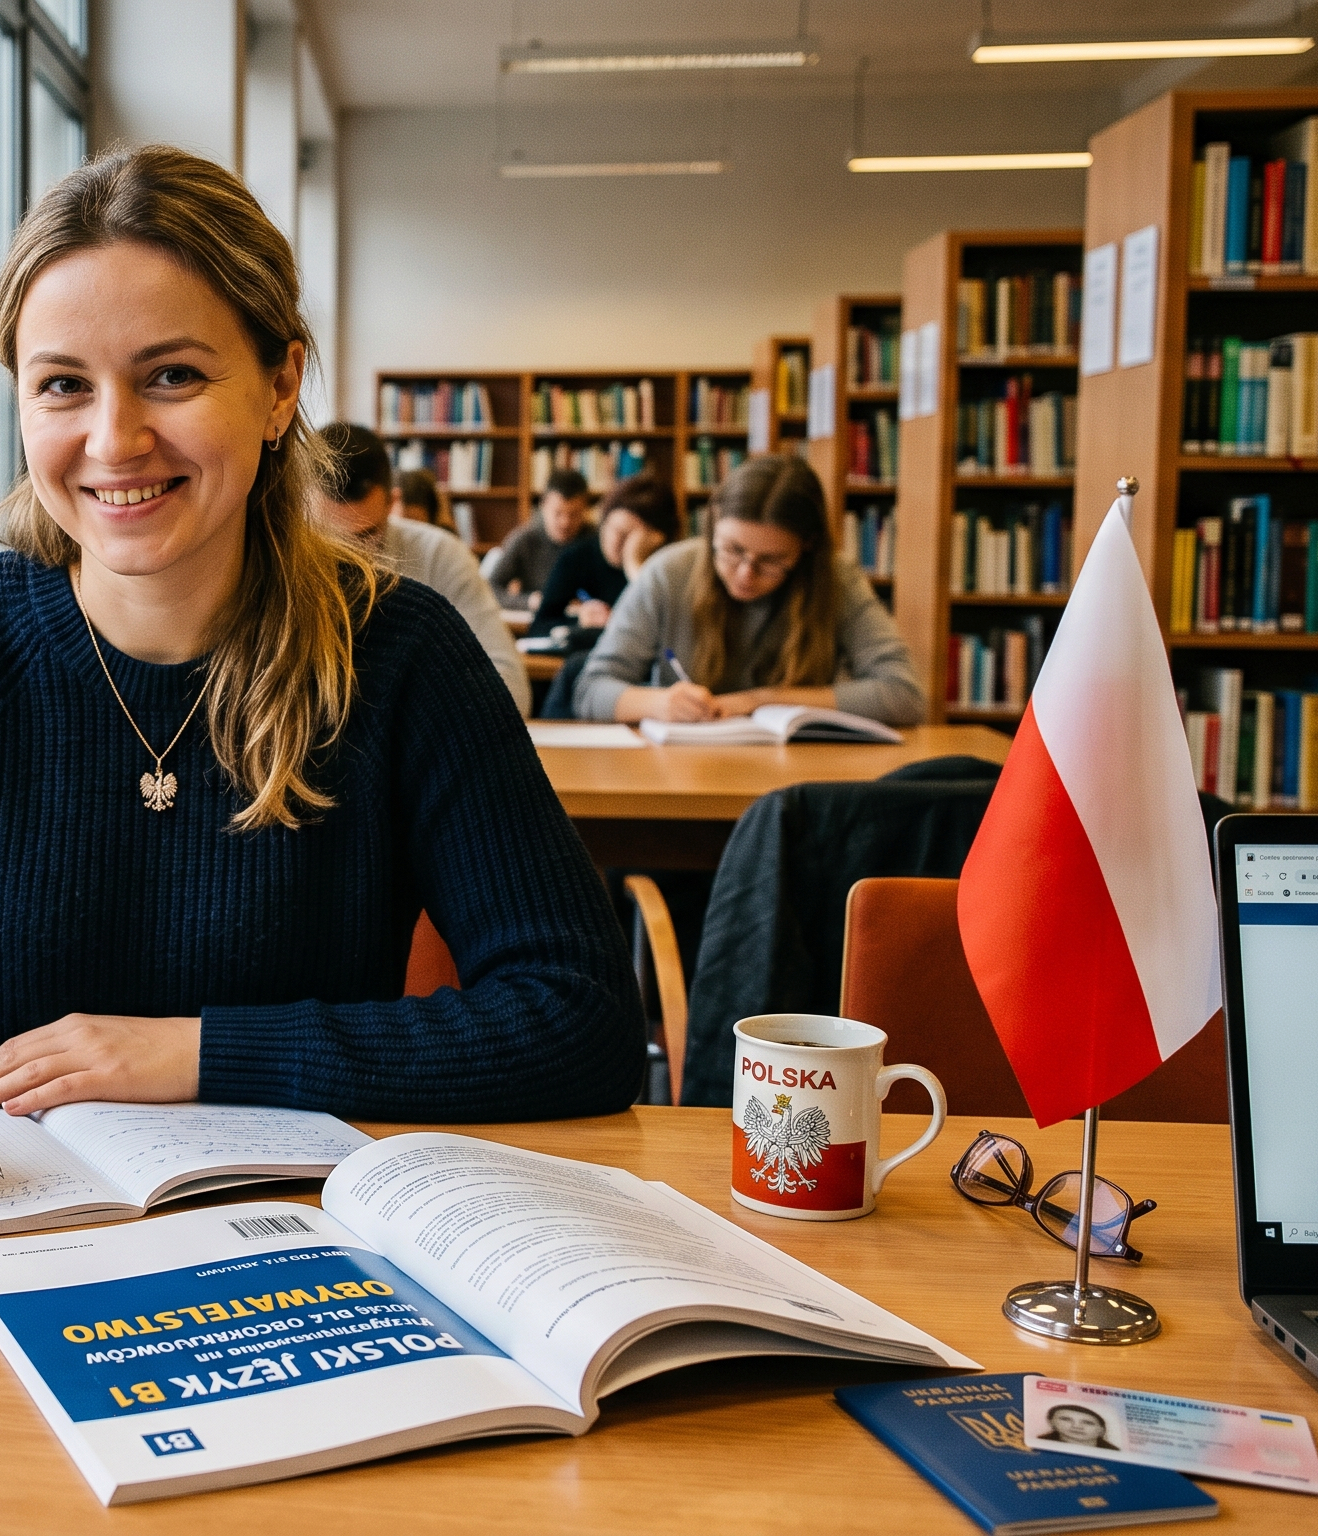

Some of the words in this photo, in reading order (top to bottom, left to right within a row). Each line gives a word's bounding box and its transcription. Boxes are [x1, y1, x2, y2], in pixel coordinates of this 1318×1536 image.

[742, 1057, 837, 1090] POLSKA
[63, 1280, 394, 1343] OBYWATELSTWO
[309, 1331, 464, 1371] POLSKI
[168, 1352, 302, 1399] JĘZYK
[109, 1381, 166, 1409] B1
[156, 1431, 195, 1452] B1
